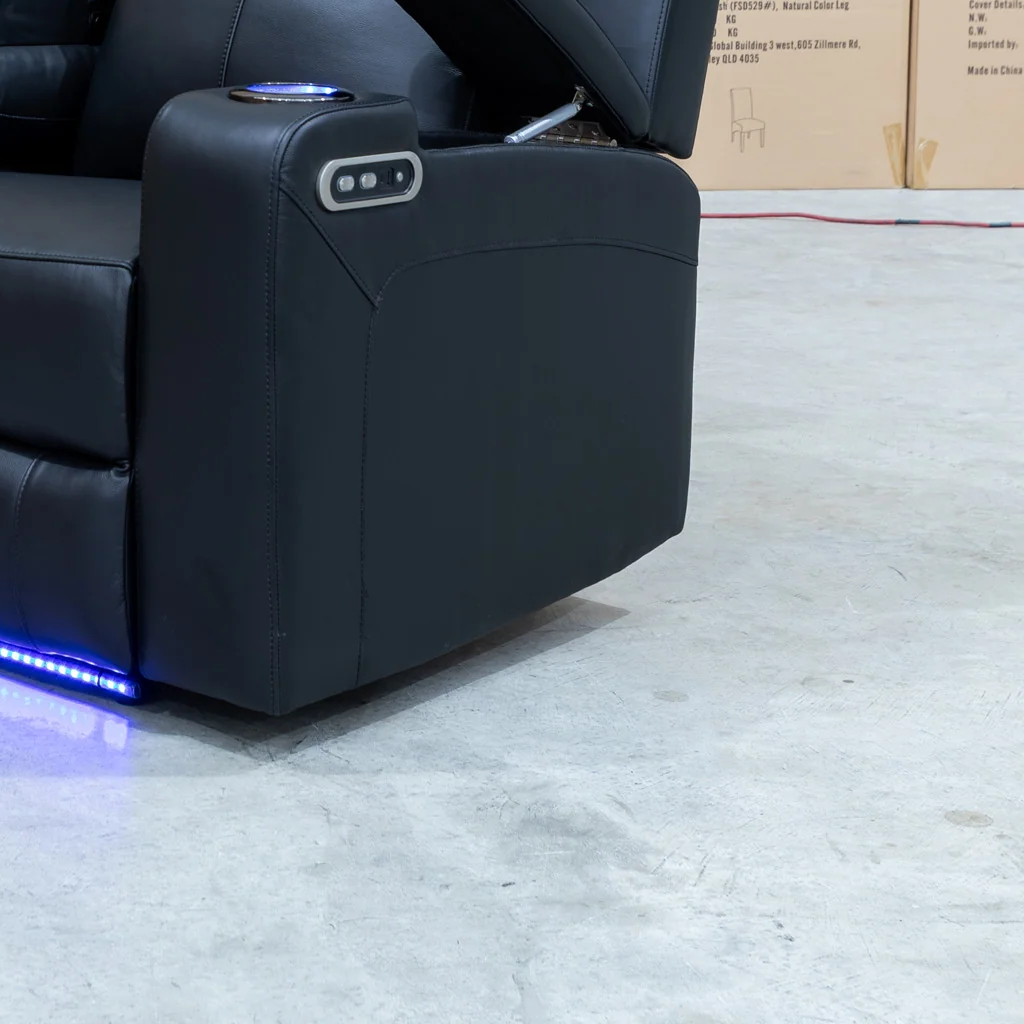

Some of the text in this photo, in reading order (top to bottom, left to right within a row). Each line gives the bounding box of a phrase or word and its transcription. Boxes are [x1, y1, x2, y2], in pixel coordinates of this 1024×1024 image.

[814, 40, 847, 49] Zillmere
[967, 65, 1023, 75] Made in China
